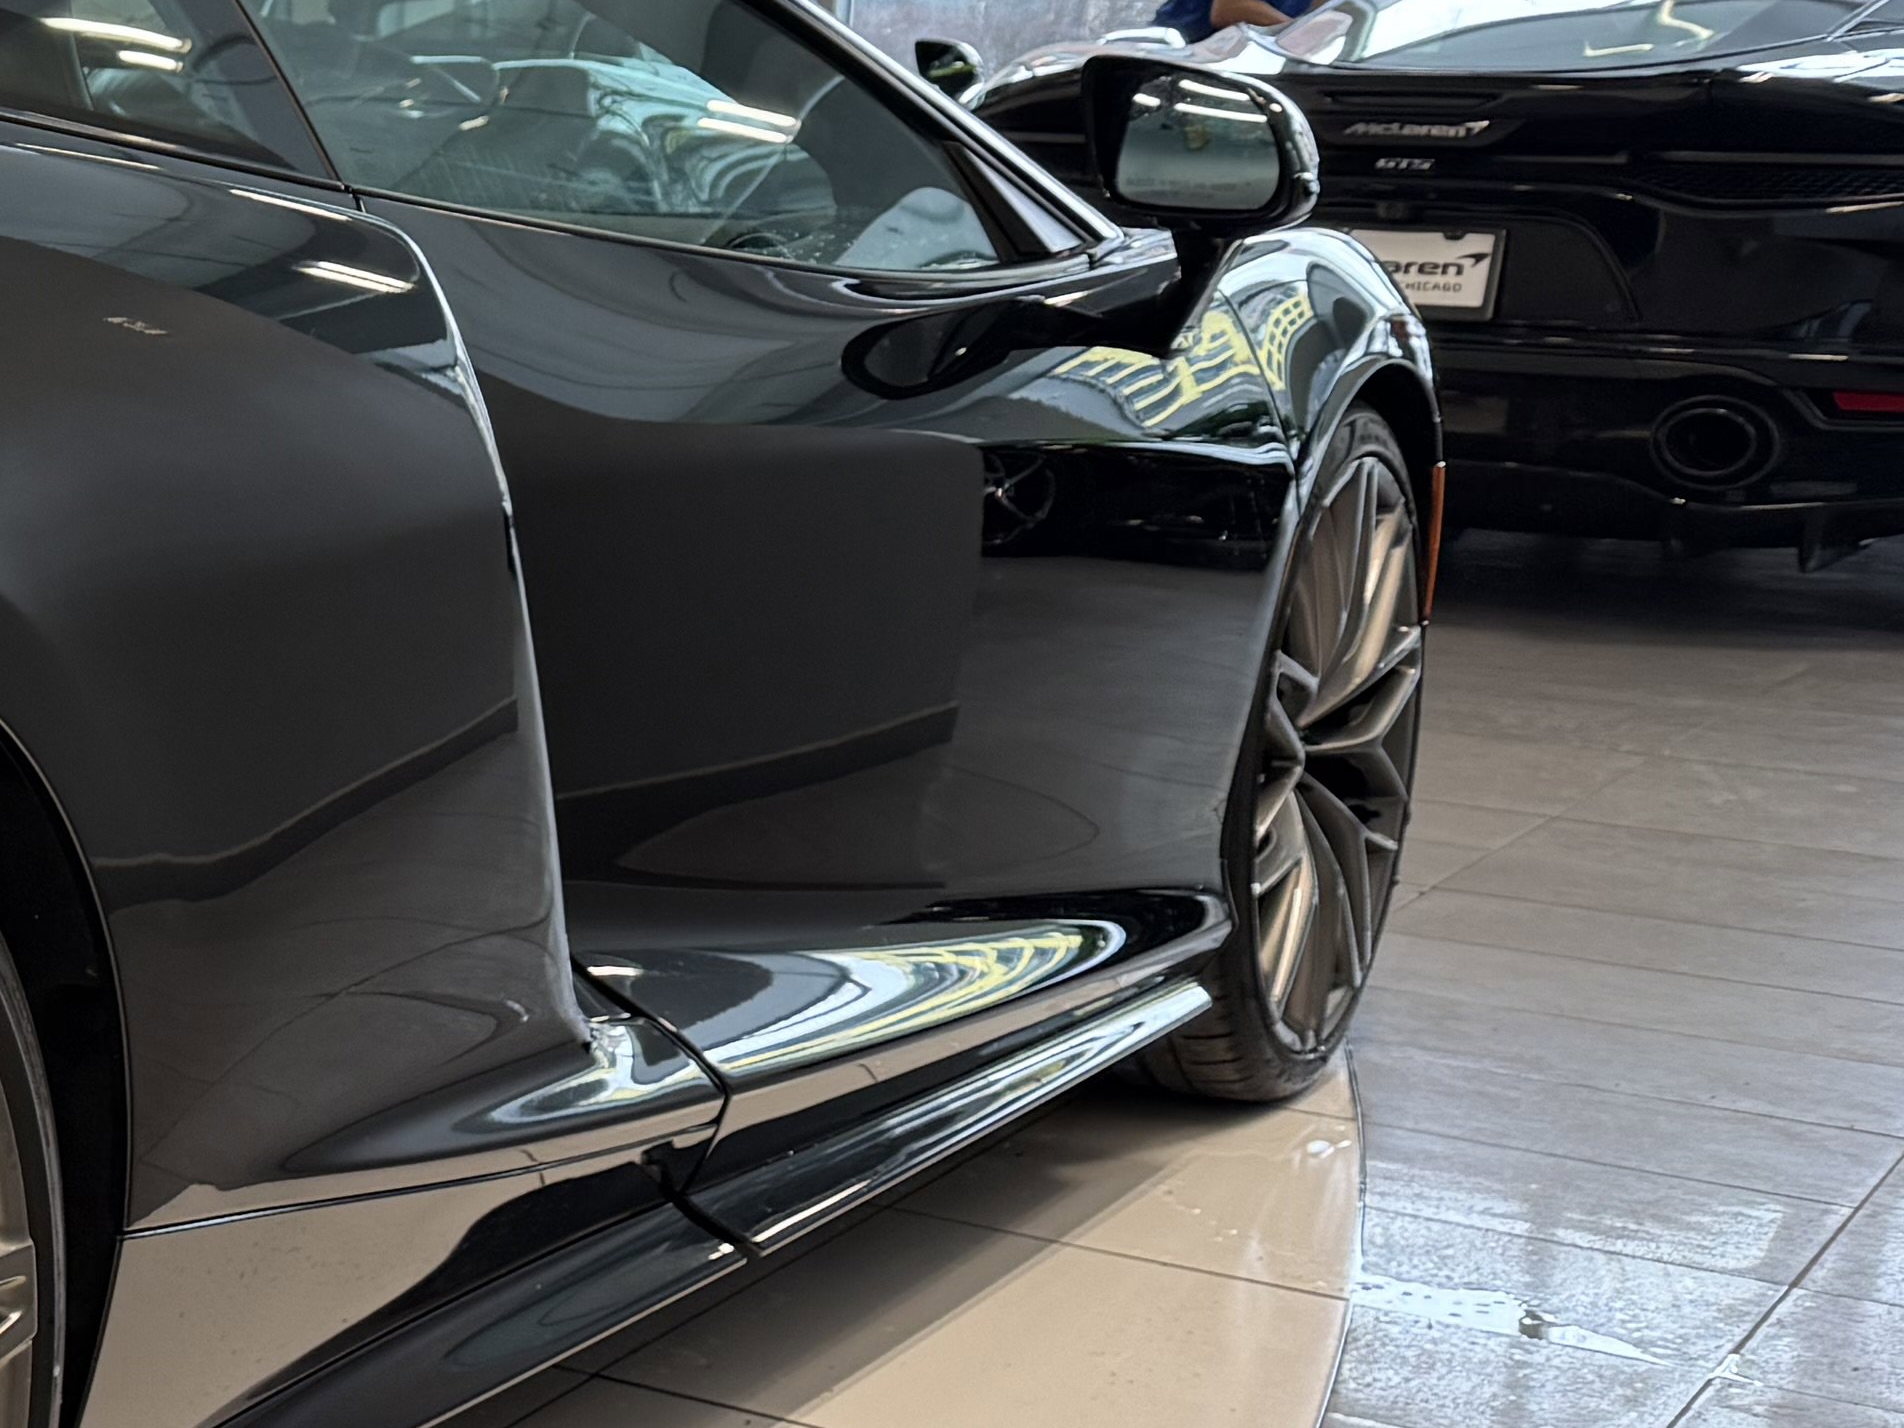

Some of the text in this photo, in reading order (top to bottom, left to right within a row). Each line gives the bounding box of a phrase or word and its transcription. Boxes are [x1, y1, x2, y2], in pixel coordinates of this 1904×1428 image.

[1344, 122, 1468, 138] McLaren
[1374, 157, 1435, 170] GTS
[1381, 259, 1465, 276] aren
[1400, 280, 1463, 293] HICAGO
